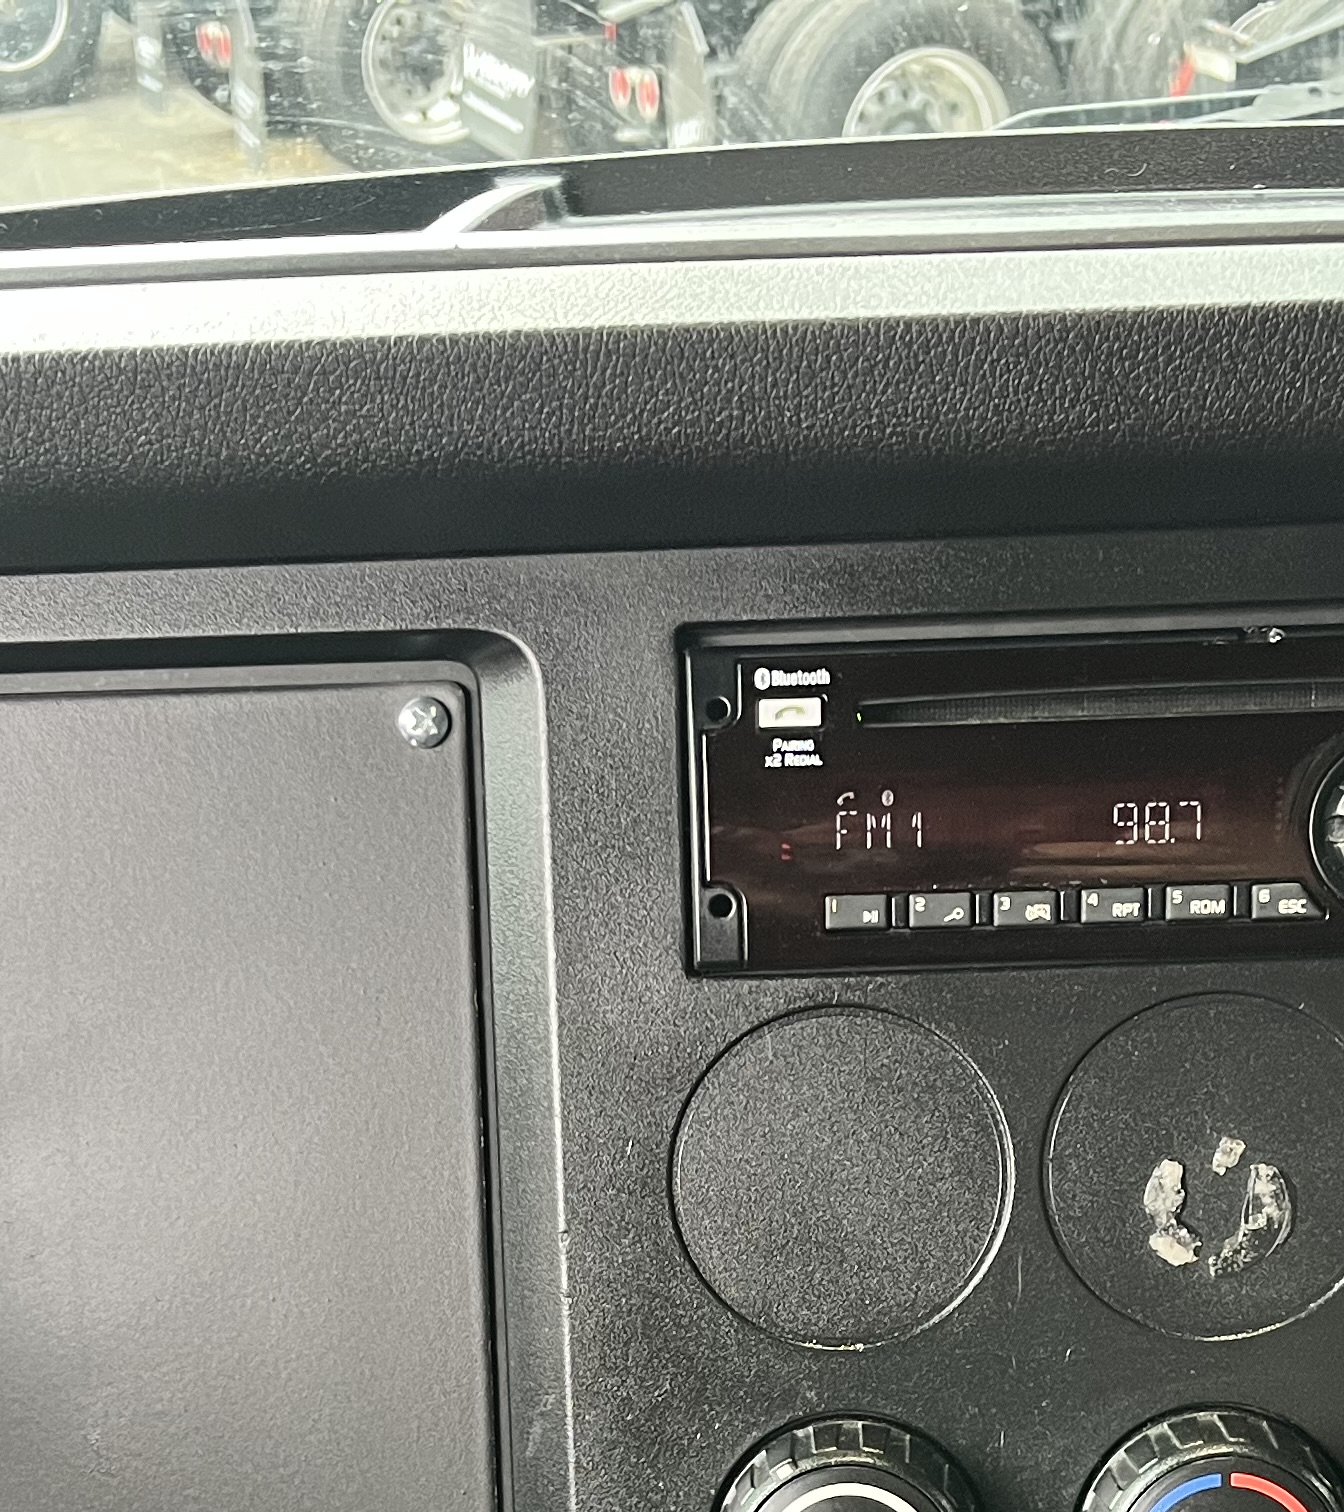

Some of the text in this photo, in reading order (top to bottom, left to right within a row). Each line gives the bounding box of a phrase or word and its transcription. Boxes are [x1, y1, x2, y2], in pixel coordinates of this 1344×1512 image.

[771, 668, 830, 686] Bluetooth
[1113, 800, 1202, 845] 98.7
[999, 896, 1011, 911] 3
[1086, 893, 1099, 907] 4
[1258, 889, 1271, 903] 6
[914, 897, 926, 912] 2
[1111, 902, 1141, 919] RPT
[1277, 898, 1308, 915] ESC
